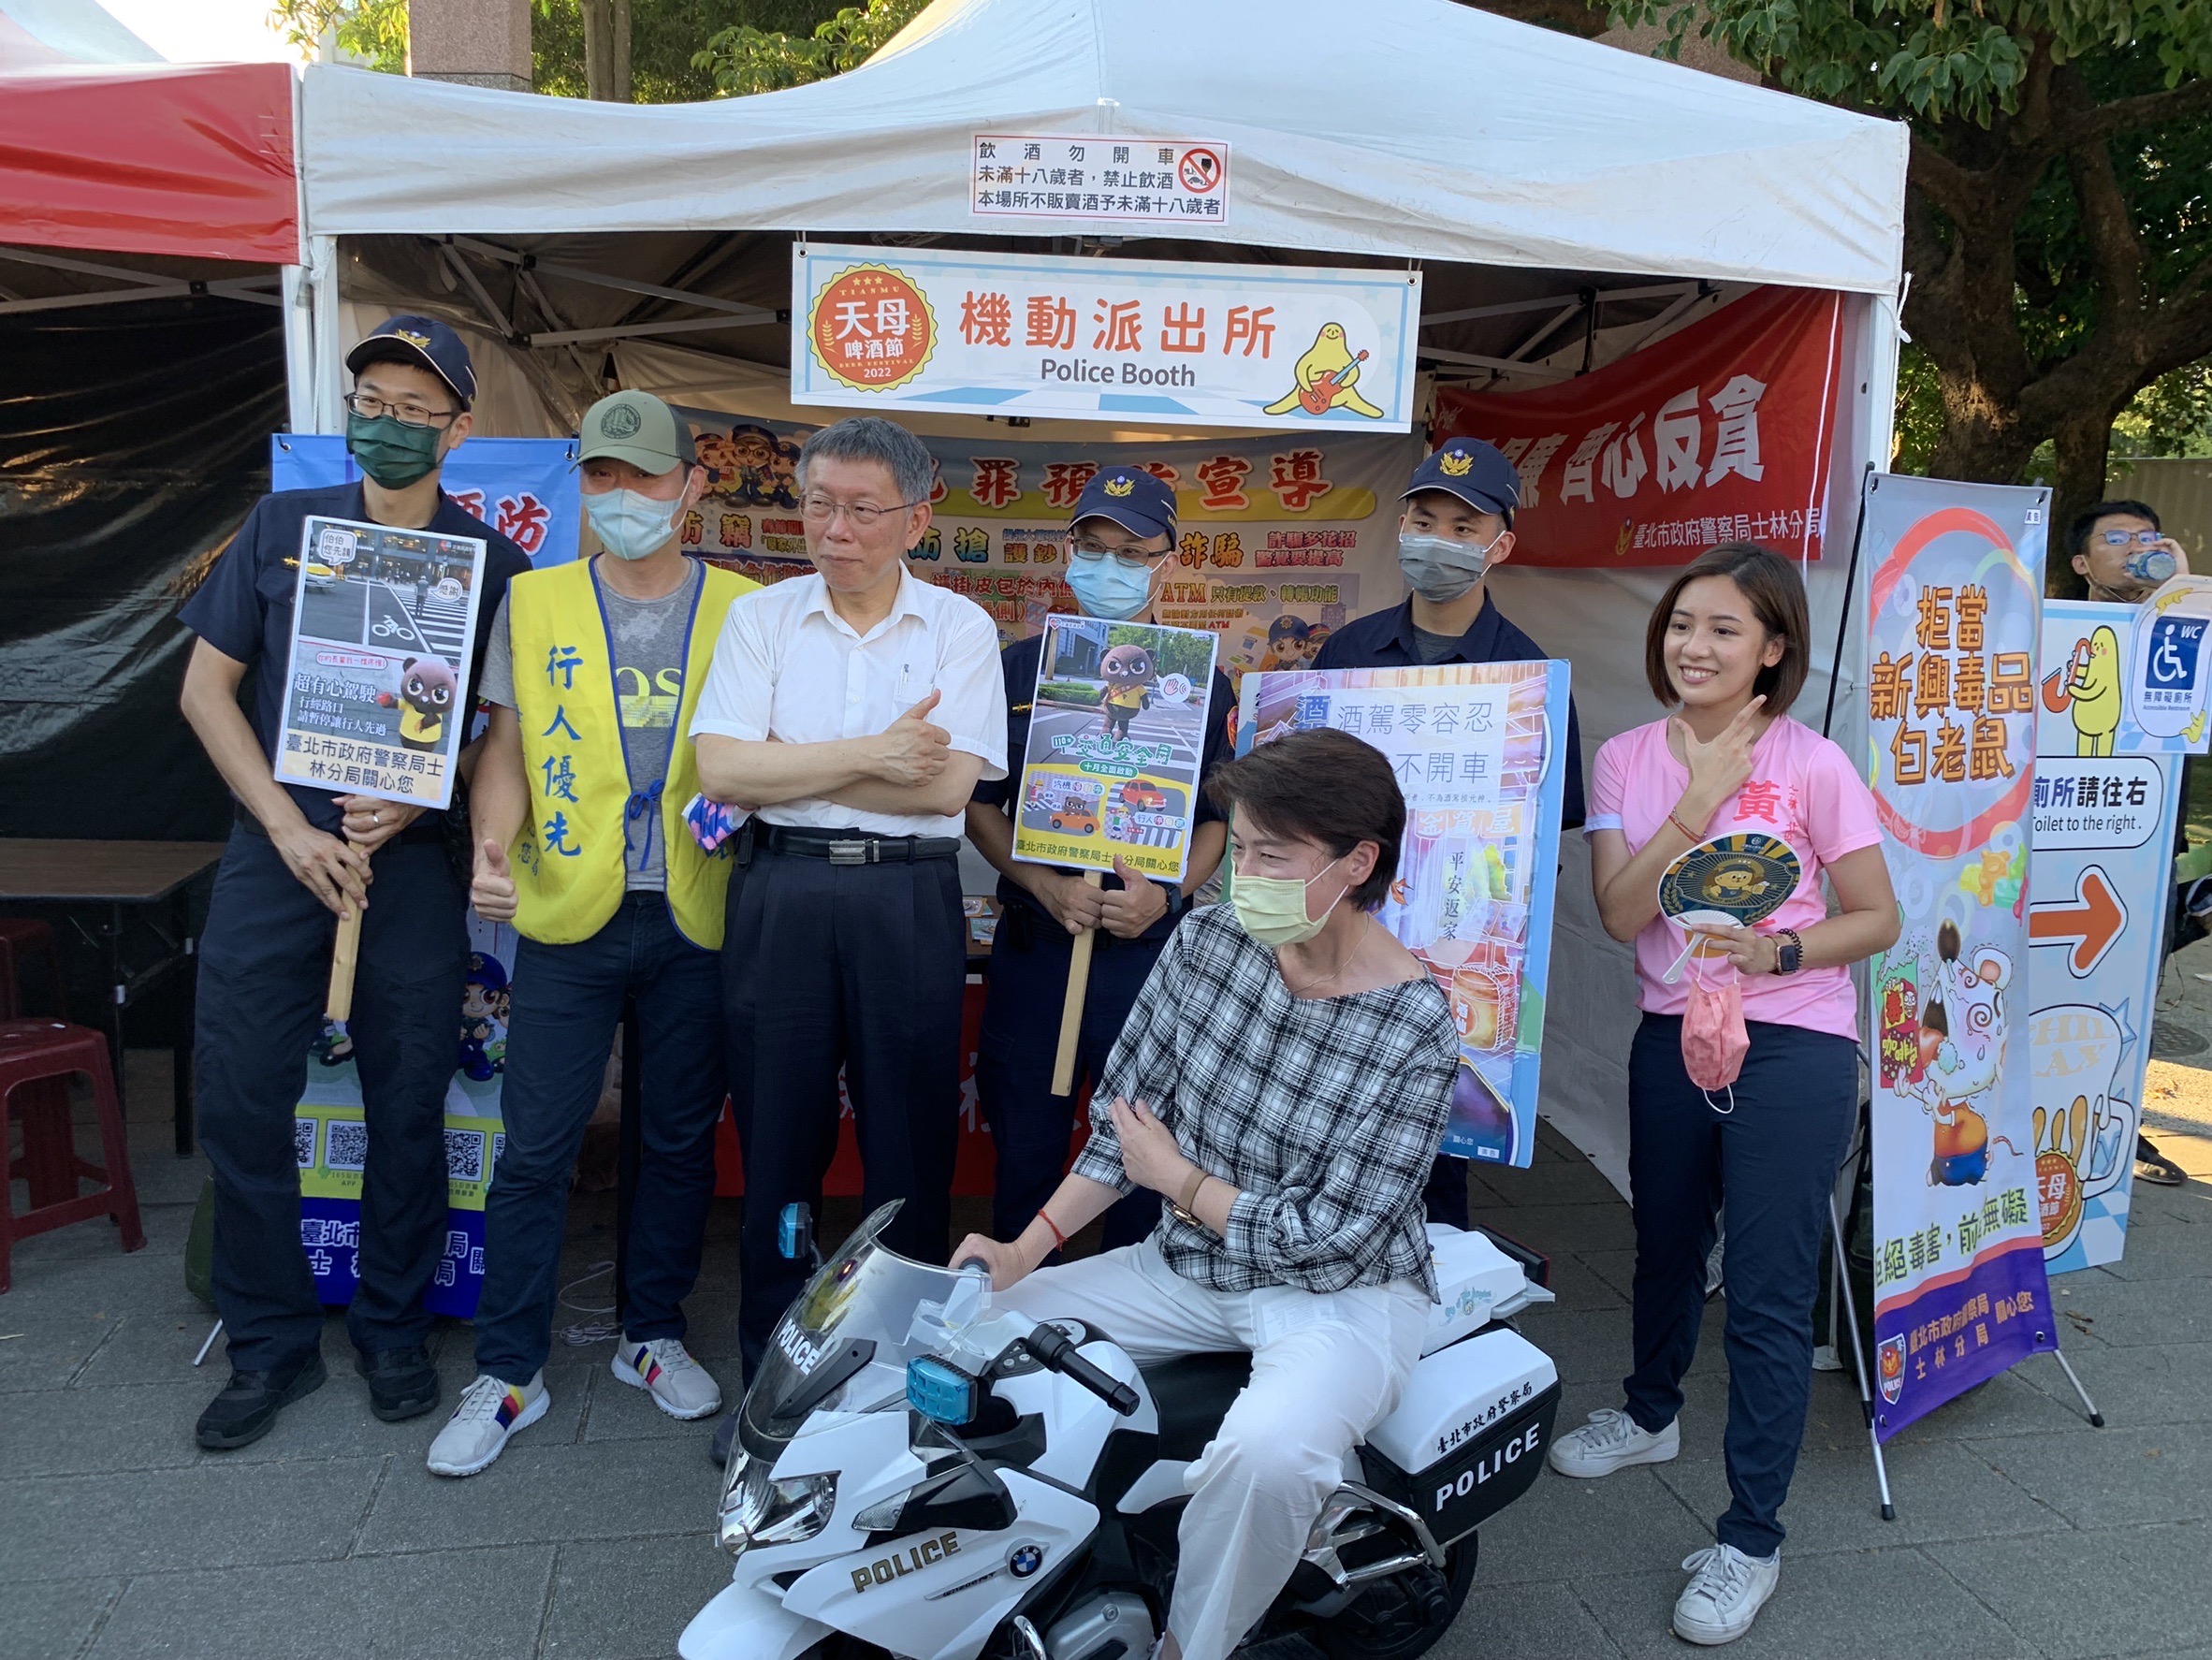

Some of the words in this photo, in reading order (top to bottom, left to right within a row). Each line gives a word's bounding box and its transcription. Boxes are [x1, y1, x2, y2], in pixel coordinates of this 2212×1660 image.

[978, 166, 1173, 190] 未滿十八歲者，禁止飲酒
[978, 189, 1221, 215] 本場所不販賣酒予未滿十八歲者
[834, 298, 910, 341] 天母
[959, 290, 1276, 360] 機動派出所
[844, 337, 905, 360] 啤酒節
[863, 367, 893, 379] 2022
[1041, 358, 1115, 387] Police
[1122, 361, 1197, 388] Booth
[325, 534, 344, 545] 伯伯
[1267, 531, 1357, 548] 詐騙多花招
[1633, 507, 1822, 550] 臺北市政府警察局士林分局
[1160, 583, 1207, 604] ATM
[1915, 584, 1987, 651] 拒當
[2181, 625, 2203, 639] WC
[294, 672, 377, 705] 超有心駕駛
[1870, 648, 2034, 721] 新興毒品
[2143, 691, 2192, 704] 無障礙廁所
[299, 695, 344, 714] 行經路口
[1337, 702, 1494, 735] 酒駕零容忍
[286, 733, 444, 778] 臺北市政府警察局士
[541, 644, 584, 857] 行人優先
[1075, 735, 1172, 767] 交通安全月
[1890, 715, 2016, 785] 白老鼠
[310, 759, 415, 794] 林分局關心您
[1138, 813, 1153, 823] 行人
[1732, 779, 1782, 824] 黃
[2066, 817, 2079, 831] to
[2083, 813, 2103, 831] the
[1442, 851, 1464, 940] 平安返家
[777, 1318, 822, 1376] POLICE
[1884, 1376, 1902, 1392] POLICE
[1436, 1381, 1533, 1455] 臺北市政府警察局
[1435, 1422, 1540, 1512] POLICE
[851, 1531, 962, 1594] POLICE
[1012, 1547, 1040, 1561] BMW
